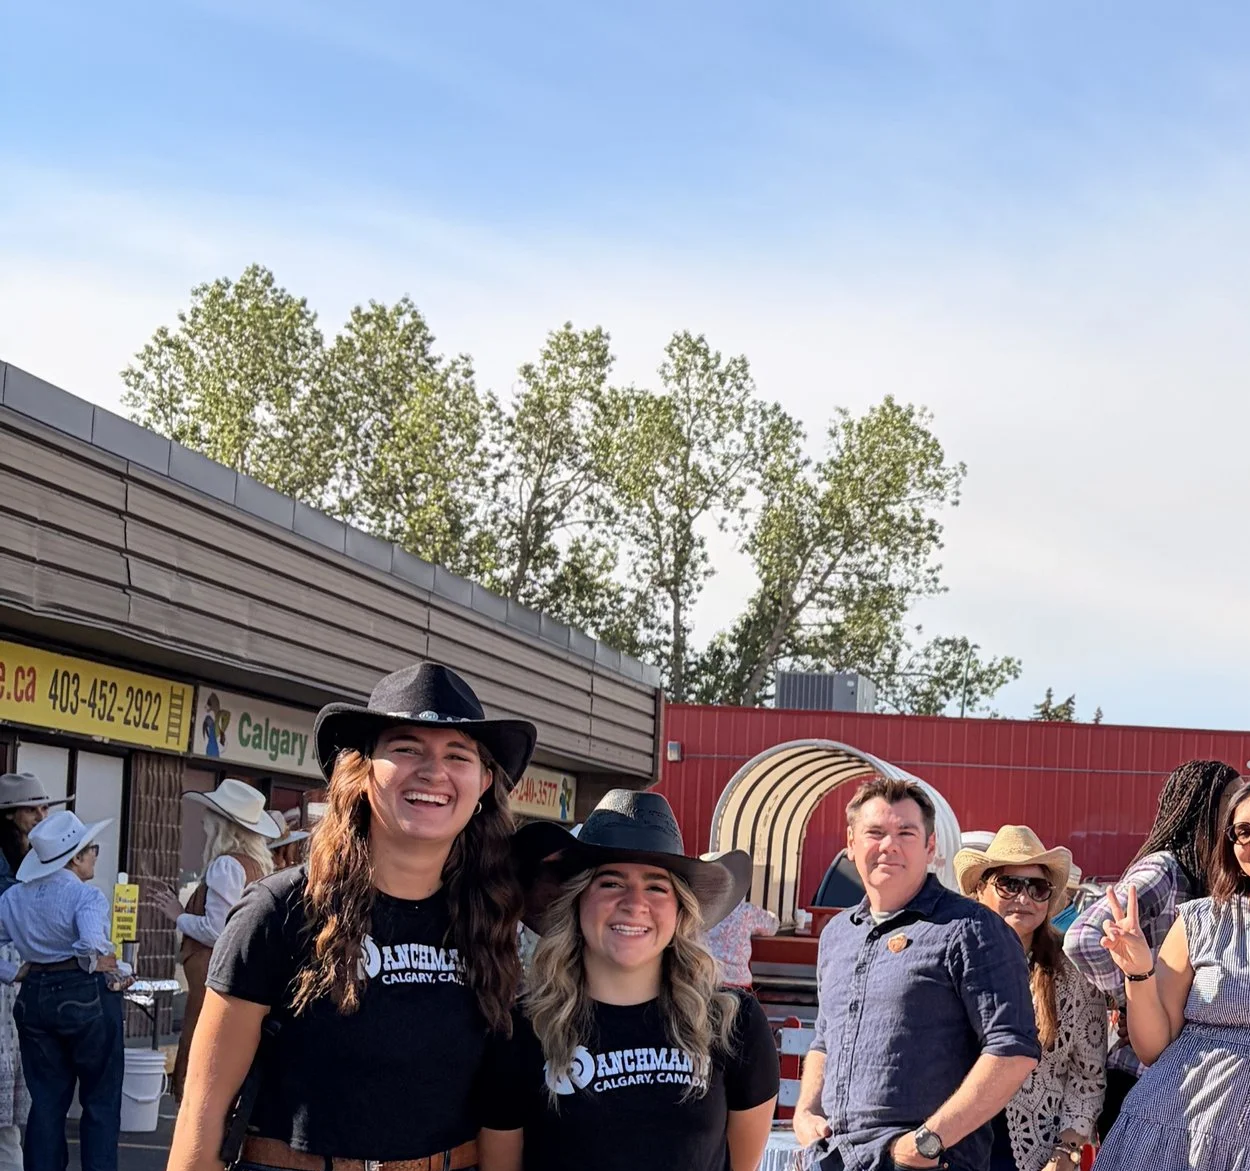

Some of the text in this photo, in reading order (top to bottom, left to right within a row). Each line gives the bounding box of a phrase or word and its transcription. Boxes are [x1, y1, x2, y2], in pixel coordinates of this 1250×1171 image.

[48, 668, 162, 731] 403-452-2922
[238, 711, 309, 766] Calgary
[382, 972, 436, 985] CALGARY,
[594, 1073, 654, 1092] CALGARY,
